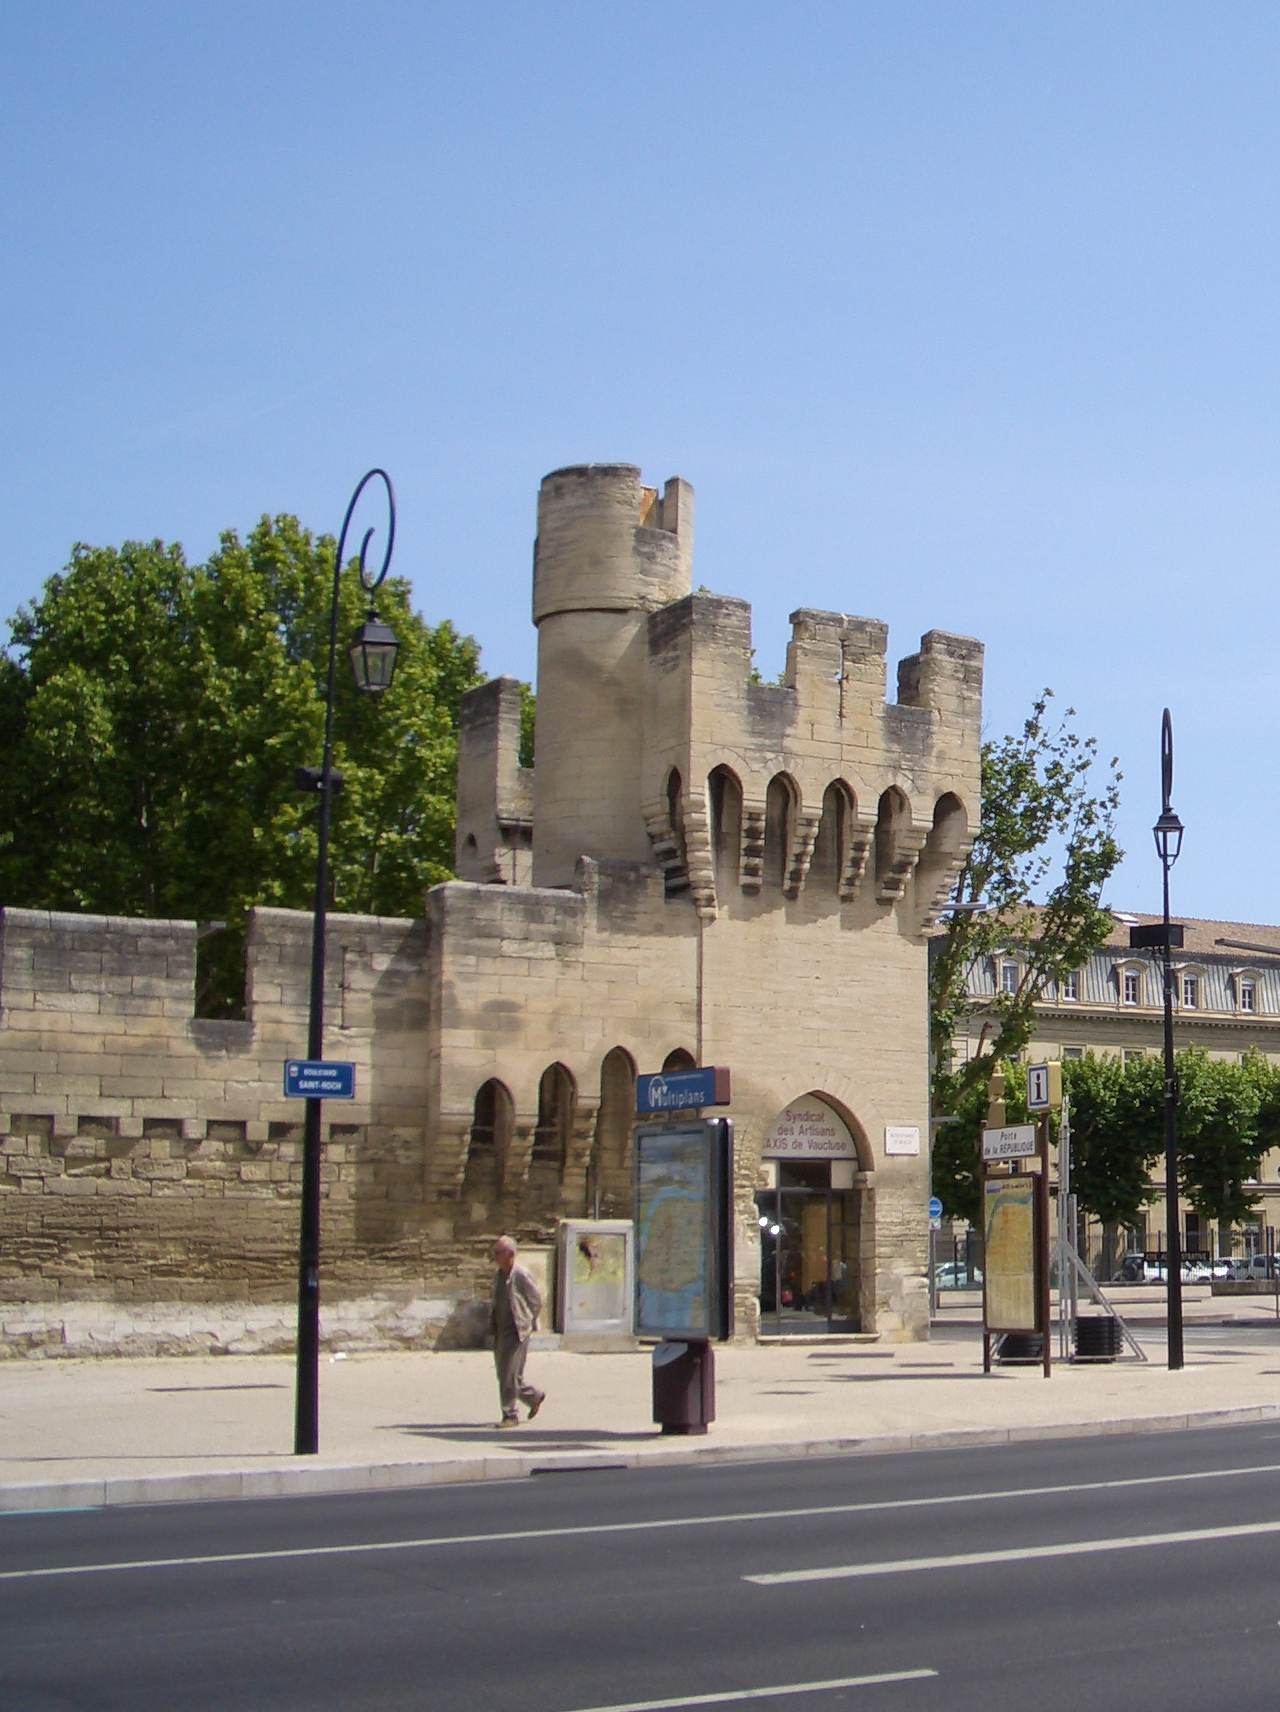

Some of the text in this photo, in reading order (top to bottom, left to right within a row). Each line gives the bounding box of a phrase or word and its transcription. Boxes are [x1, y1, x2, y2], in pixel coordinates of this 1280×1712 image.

[298, 1080, 342, 1090] SAINT-ROCH
[650, 1085, 705, 1109] Multiplans
[785, 1110, 825, 1124] Syndicat
[777, 1124, 836, 1136] des Artisans
[1001, 1131, 1017, 1140] Porte
[791, 1139, 803, 1150] de
[807, 1139, 847, 1151] Vaucluse
